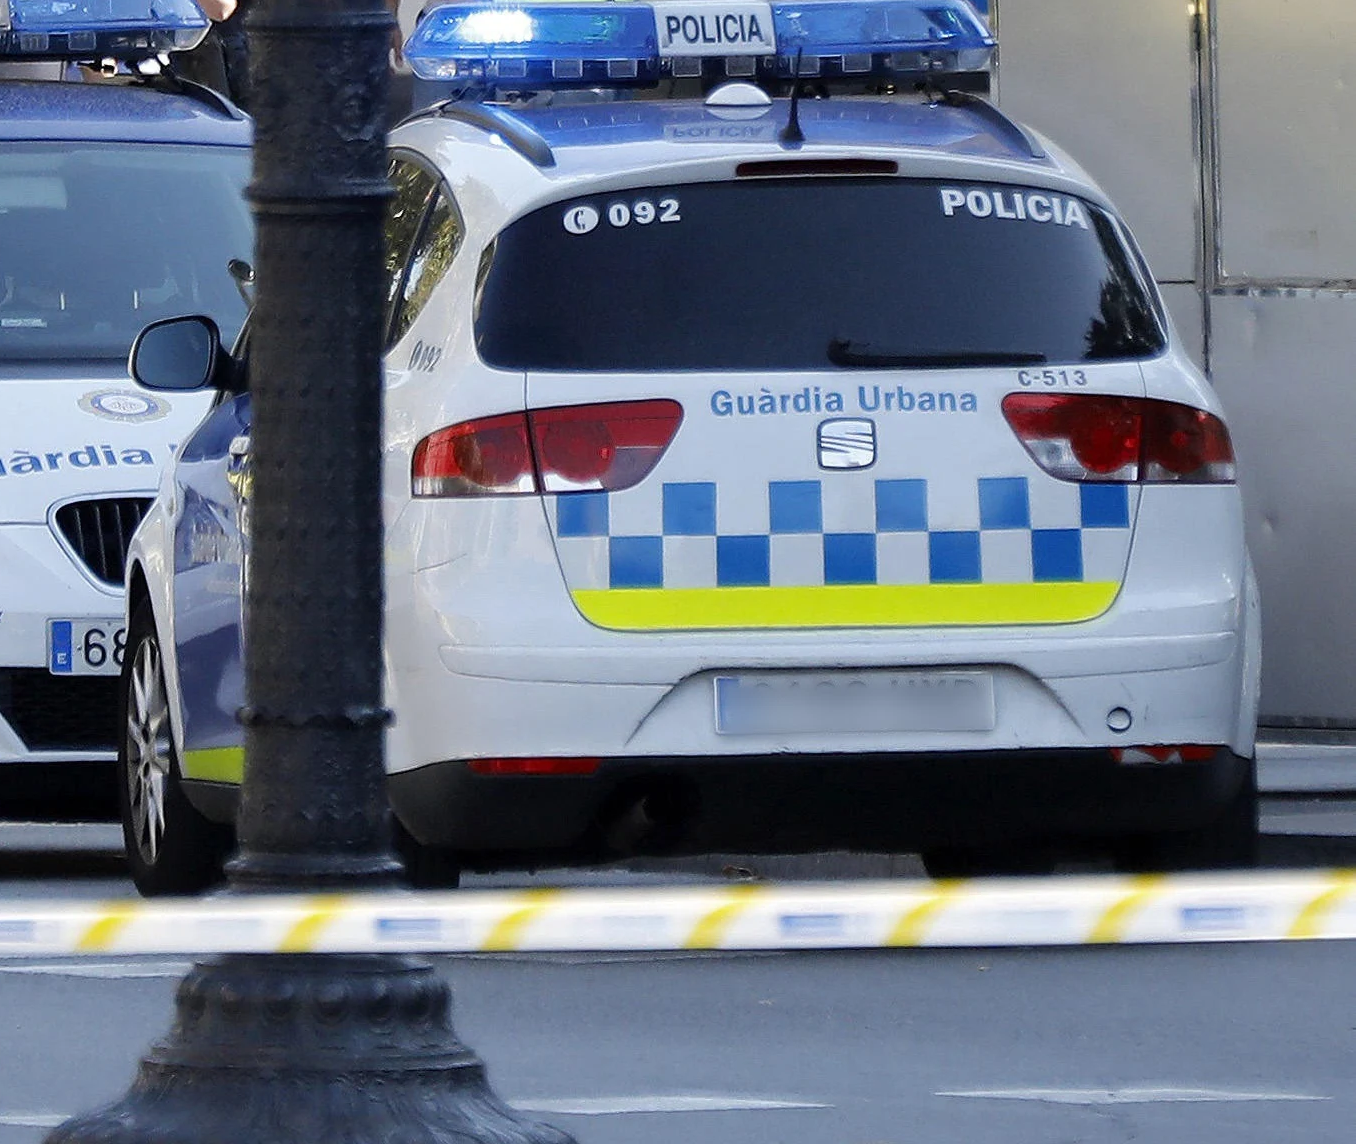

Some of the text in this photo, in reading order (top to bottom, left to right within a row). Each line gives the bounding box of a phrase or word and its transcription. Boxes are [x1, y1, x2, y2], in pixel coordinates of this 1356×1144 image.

[665, 14, 764, 43] POLICIA
[608, 199, 681, 228] 092
[940, 189, 1088, 229] POLICIA
[1018, 370, 1087, 387] C-513
[710, 386, 978, 416] Guàrdia Urbana
[57, 653, 67, 665] E
